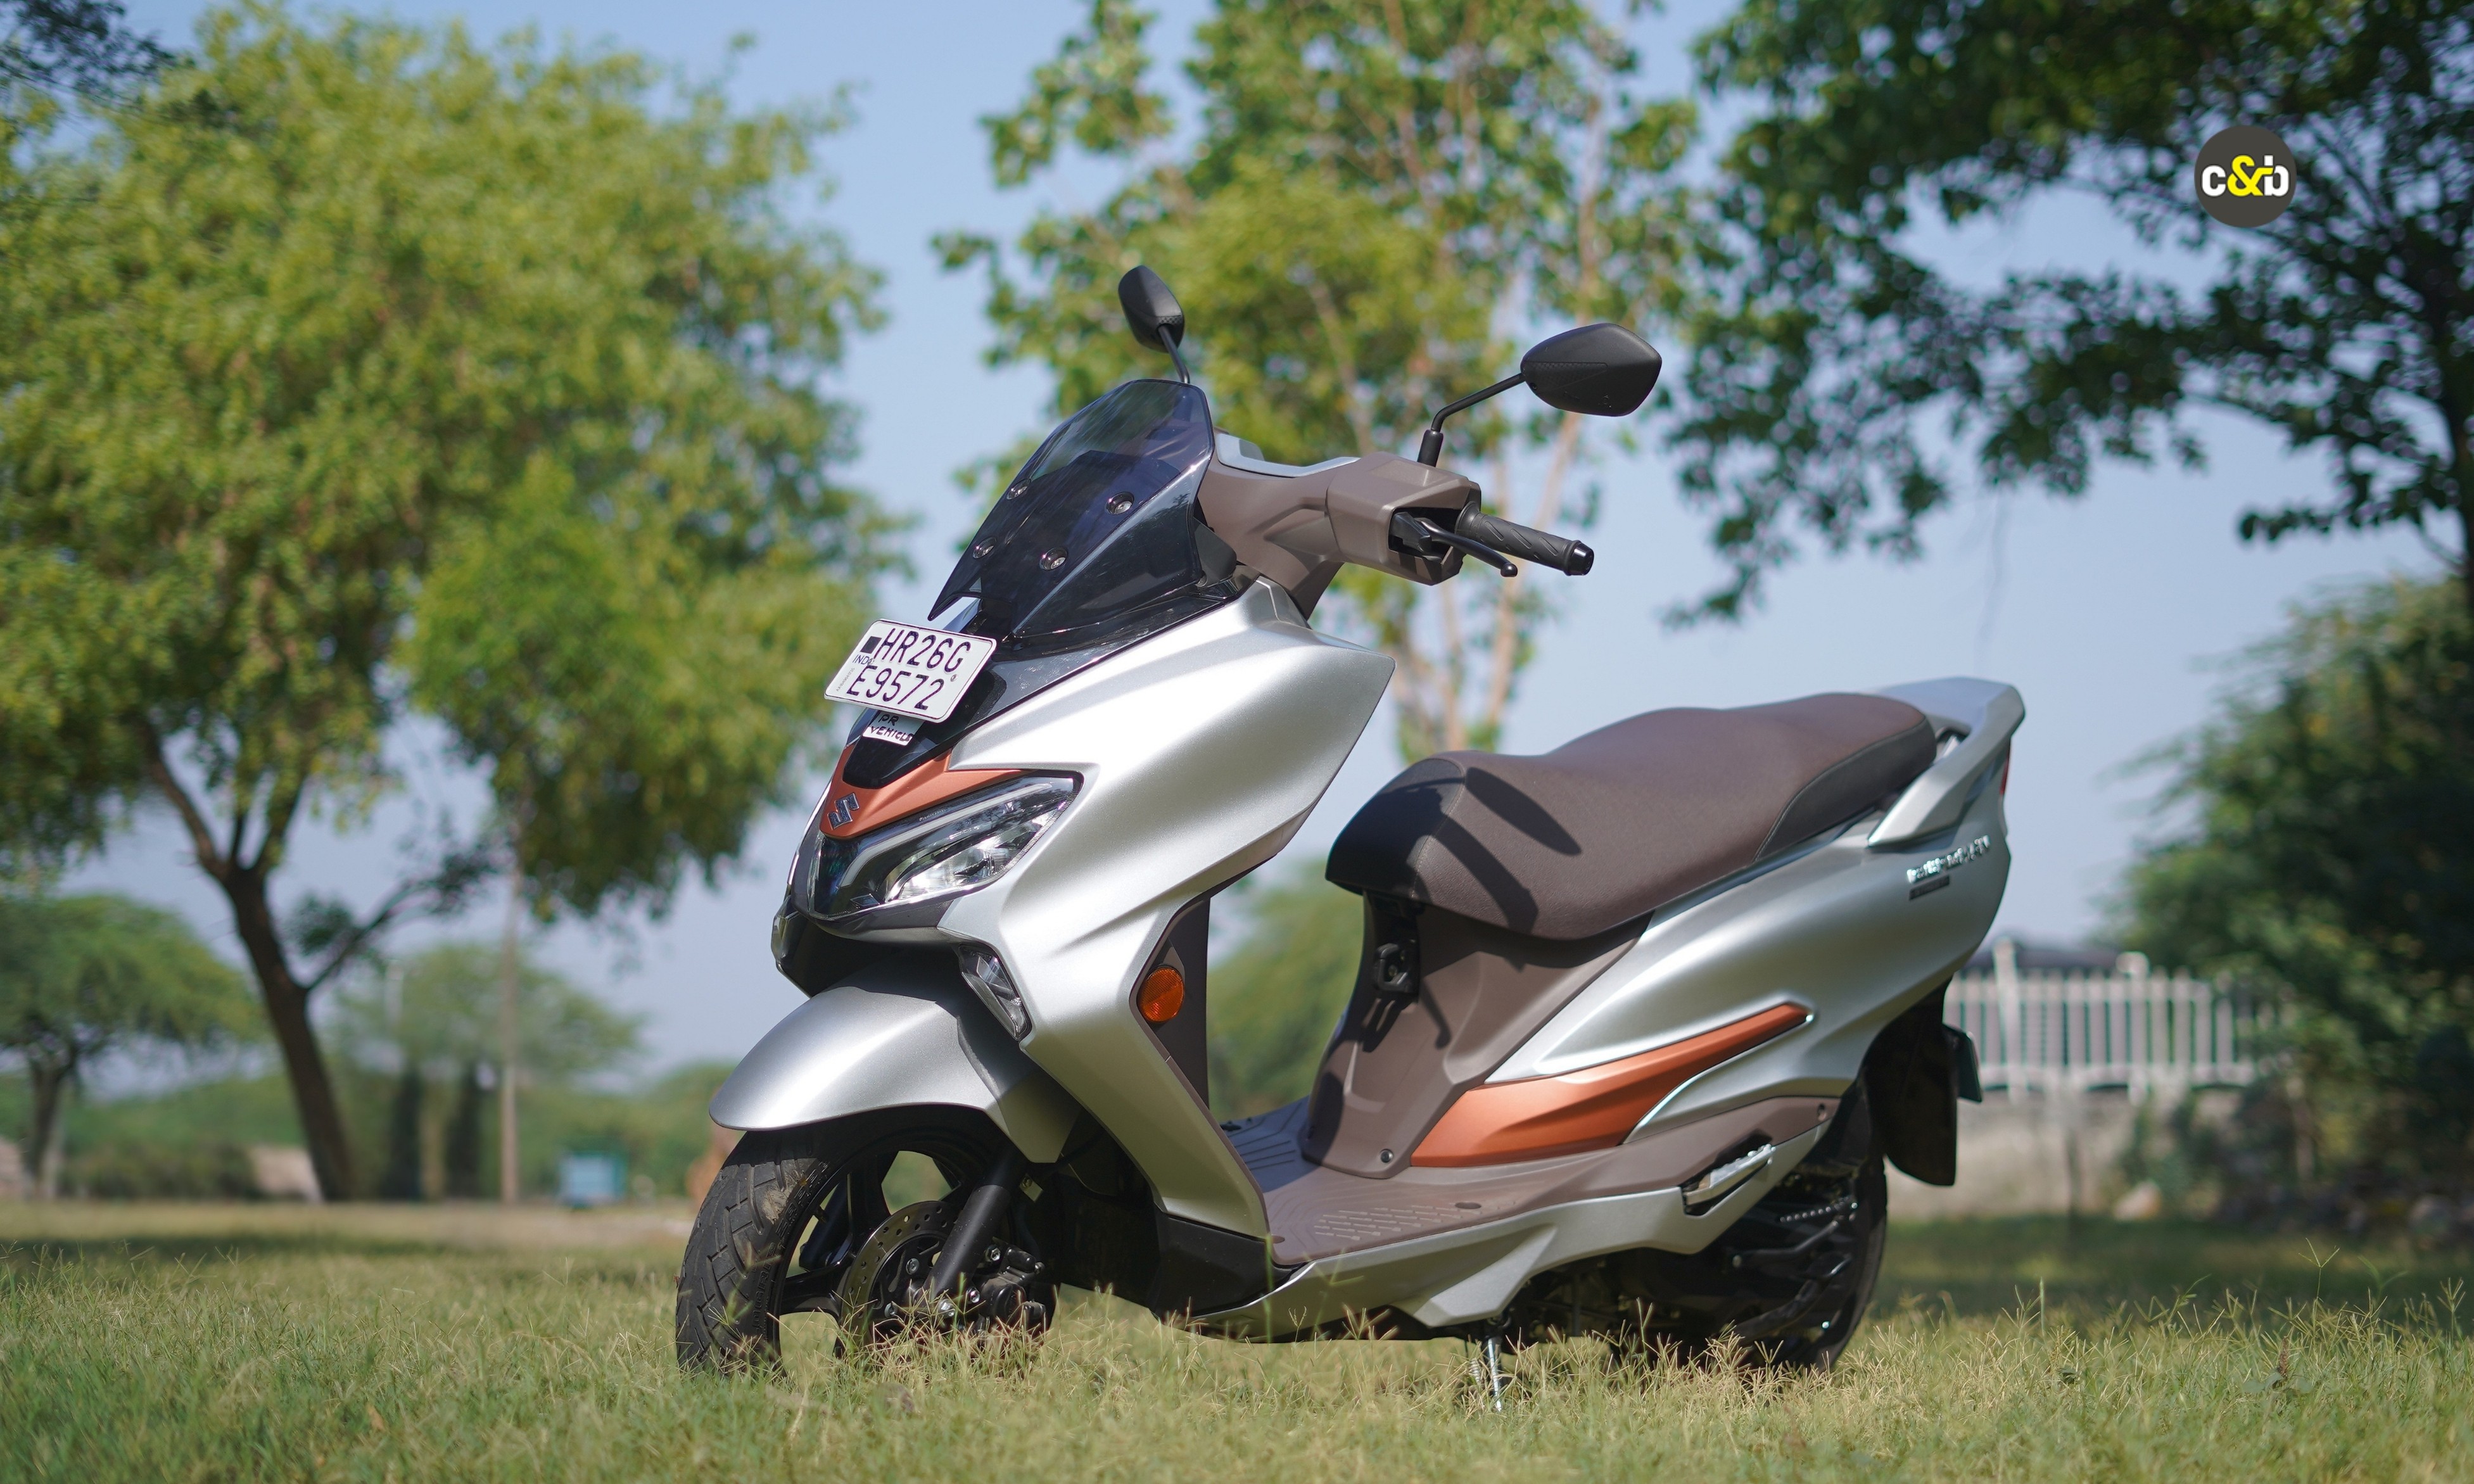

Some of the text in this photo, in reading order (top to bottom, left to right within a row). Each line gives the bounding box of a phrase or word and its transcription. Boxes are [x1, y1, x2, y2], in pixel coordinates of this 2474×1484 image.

[852, 654, 870, 665] IND
[874, 628, 971, 673] HR26G
[846, 665, 945, 710] E9572
[878, 714, 899, 726] PR
[775, 1160, 831, 1239] ZAPPE
